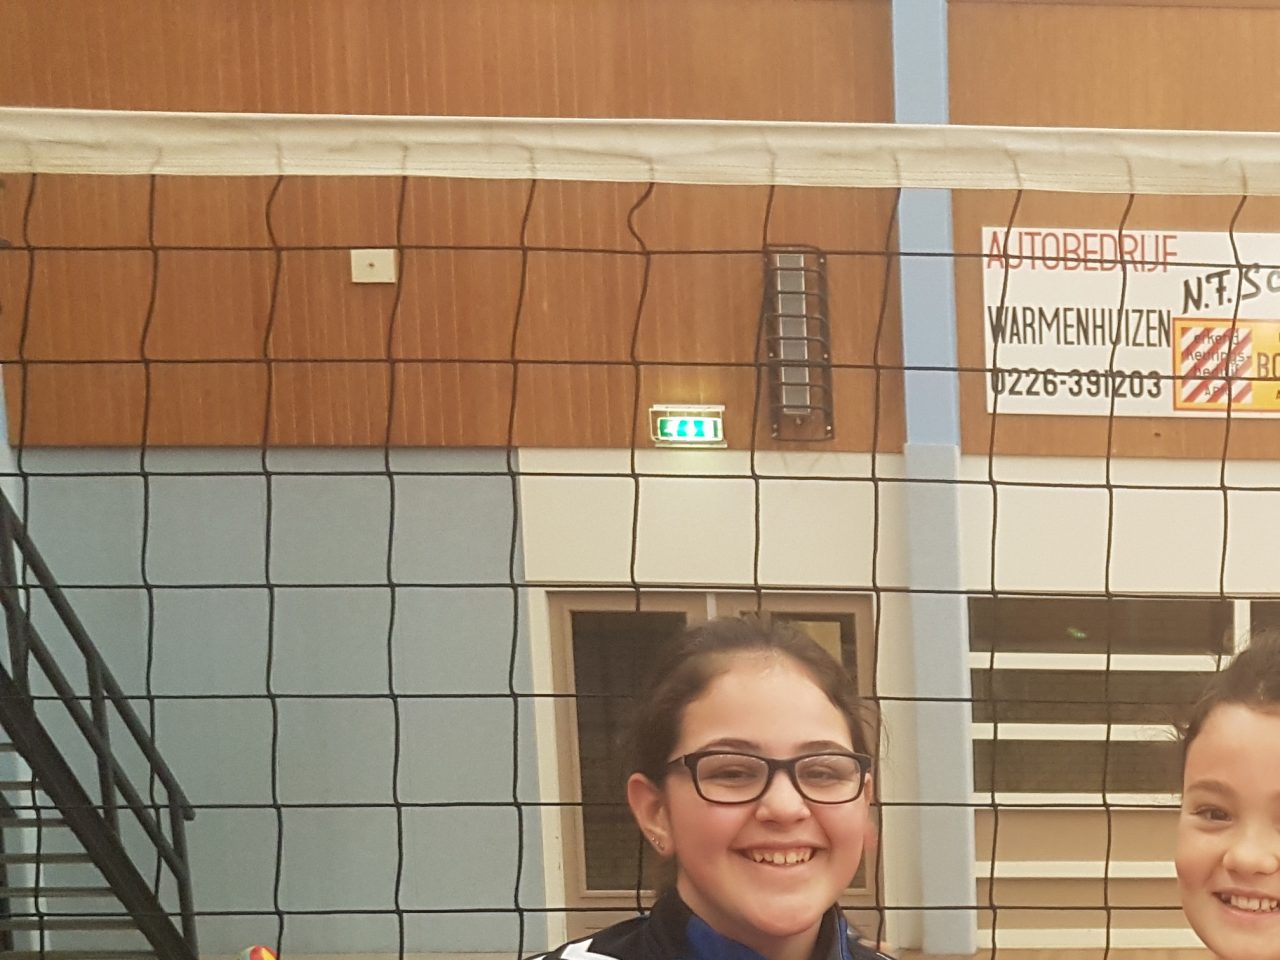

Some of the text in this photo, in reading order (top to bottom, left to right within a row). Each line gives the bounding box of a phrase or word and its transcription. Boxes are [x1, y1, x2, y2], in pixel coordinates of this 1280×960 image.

[987, 230, 1178, 272] AUTOBEDRIJF
[987, 306, 1171, 348] WARMENHUIZEN
[990, 367, 1162, 399] 0226-391203
